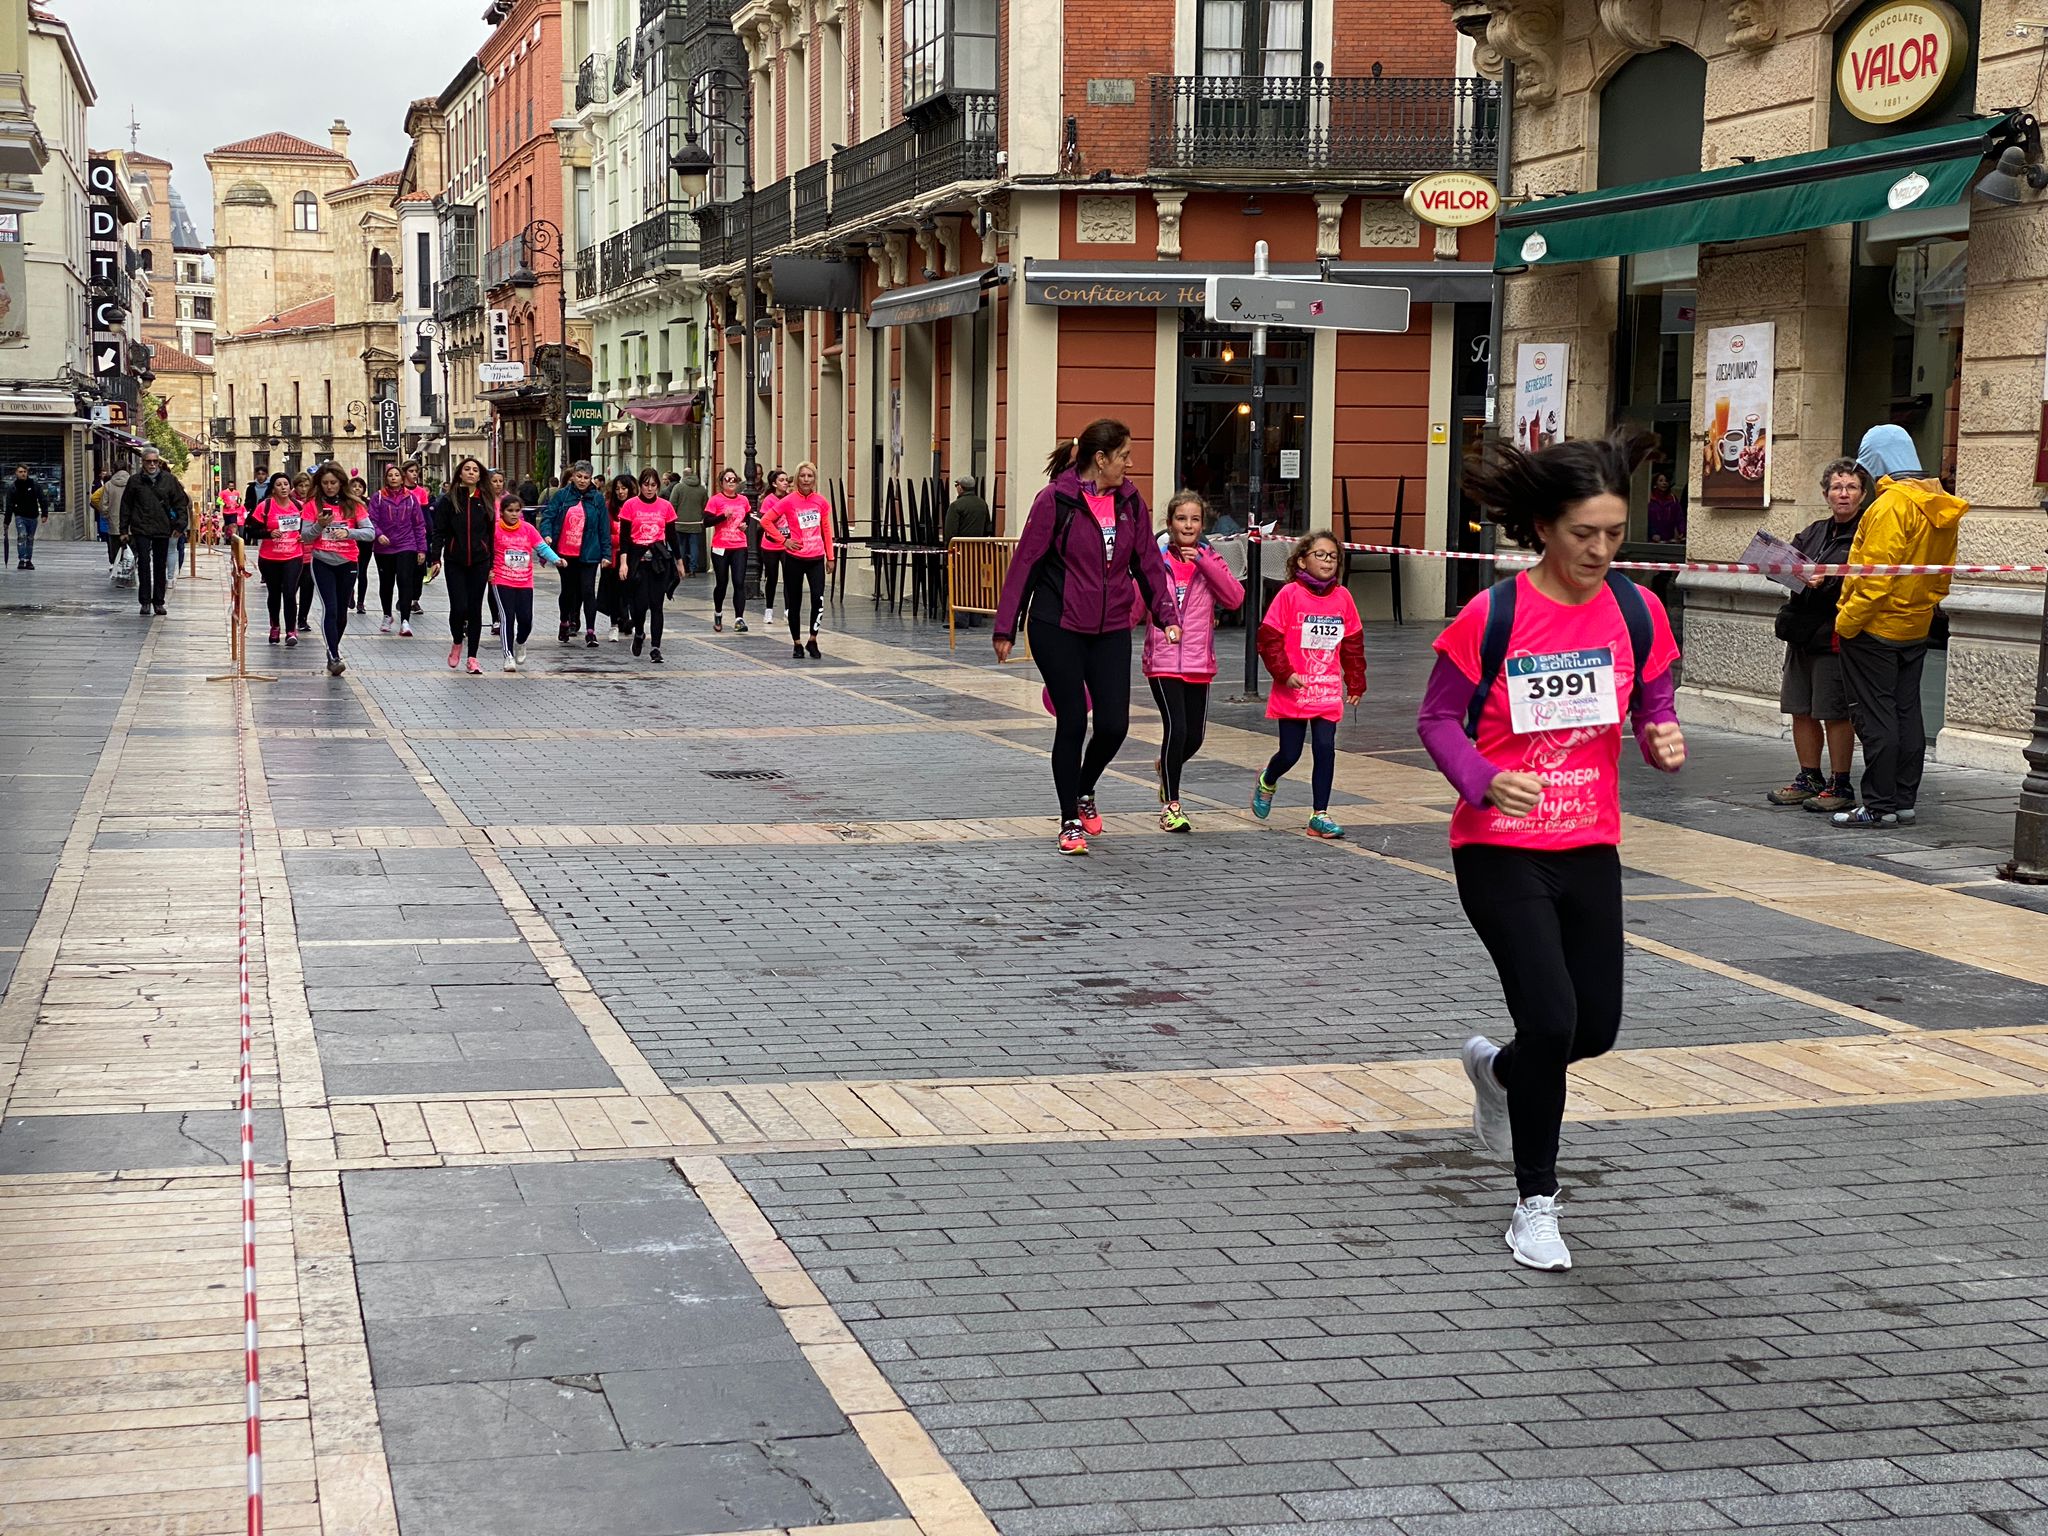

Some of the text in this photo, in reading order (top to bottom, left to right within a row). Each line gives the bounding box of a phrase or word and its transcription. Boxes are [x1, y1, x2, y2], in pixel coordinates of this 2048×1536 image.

[1868, 13, 1923, 38] CHOCOLATES
[1851, 33, 1938, 93] VALOR
[1884, 97, 1901, 107] 1881
[1433, 178, 1476, 186] CHOCOLATES
[1420, 190, 1489, 210] VALOR
[1044, 285, 1167, 303] Confitería
[493, 312, 508, 360] IRIS
[1716, 360, 1758, 381] ¿DESAYUNAMOS?
[384, 402, 396, 441] HOTEL
[571, 408, 602, 419] JOYERIA
[1310, 625, 1338, 636] 4132
[1539, 652, 1579, 662] GRUPO
[1527, 671, 1597, 699] 3991
[1491, 817, 1536, 830] ALMOM
